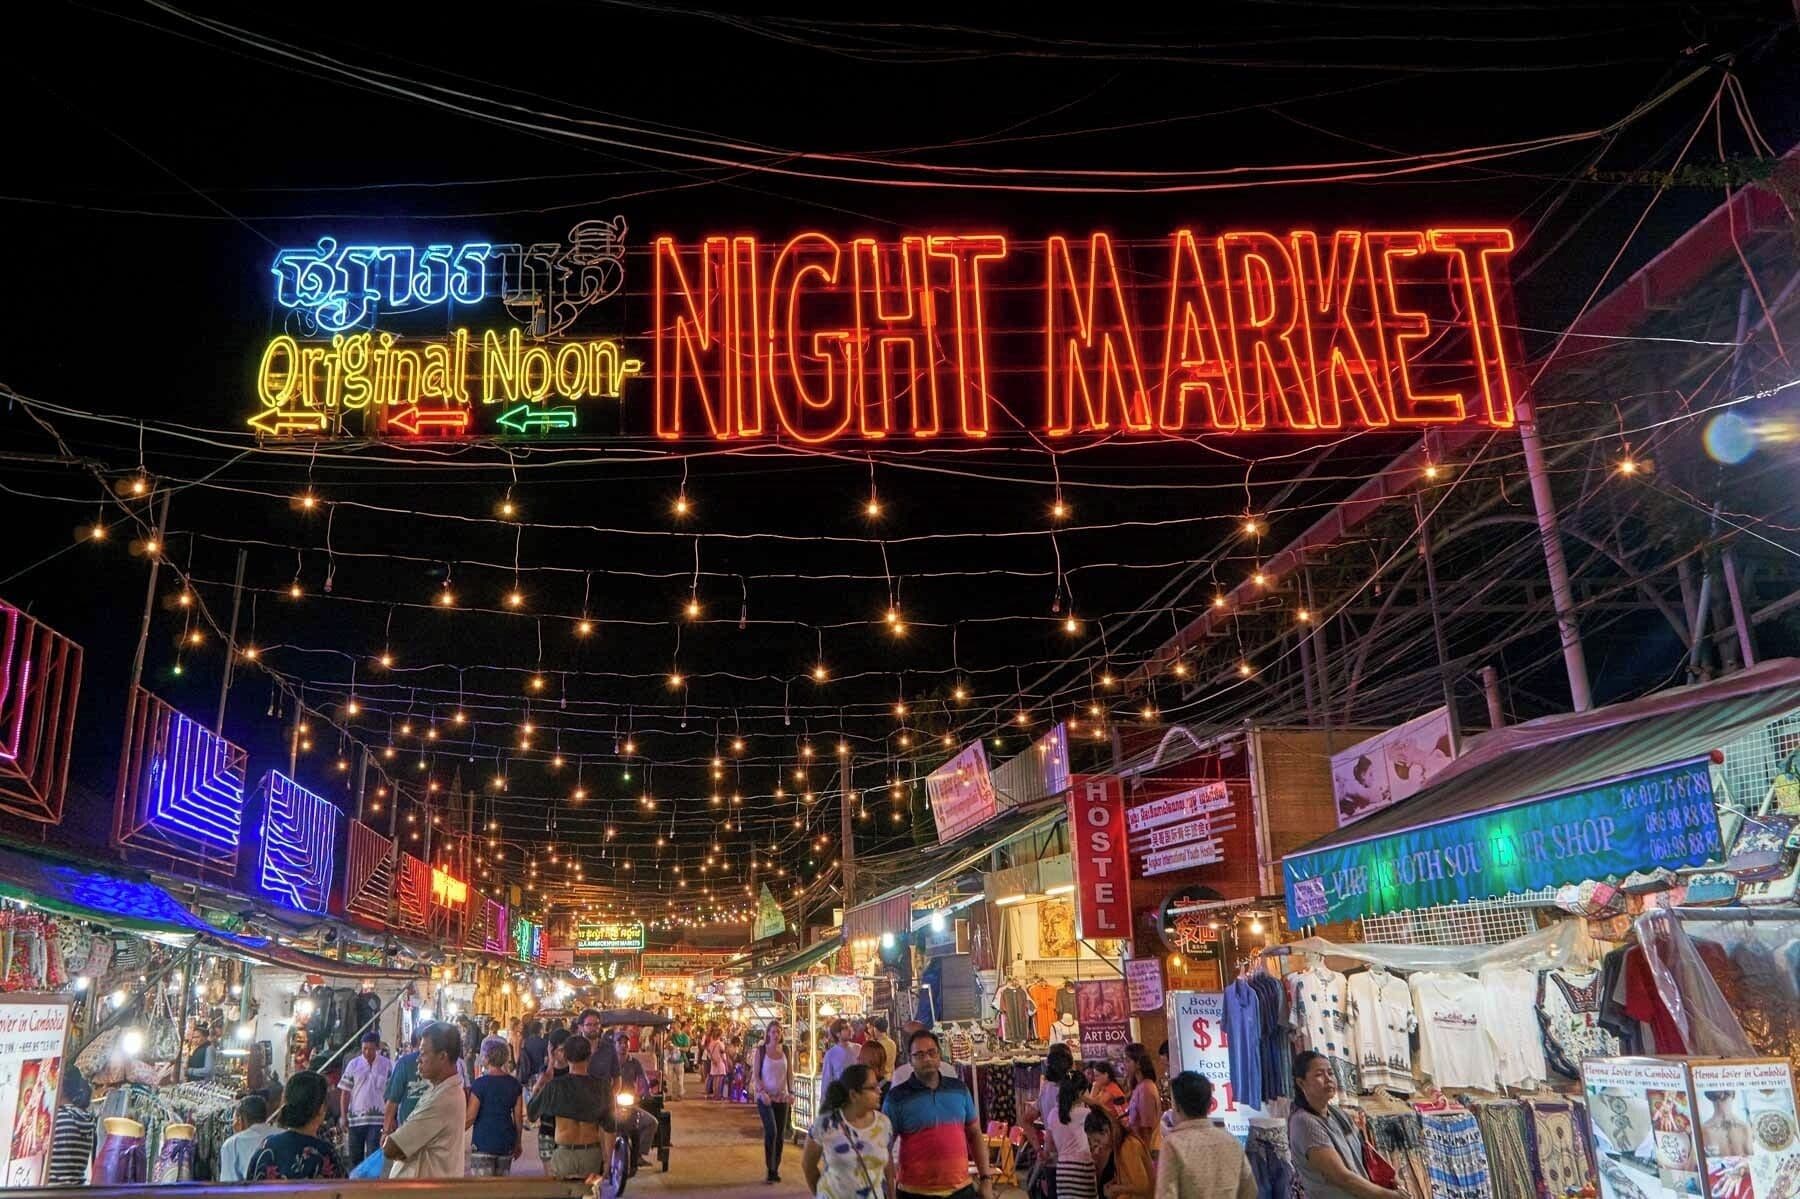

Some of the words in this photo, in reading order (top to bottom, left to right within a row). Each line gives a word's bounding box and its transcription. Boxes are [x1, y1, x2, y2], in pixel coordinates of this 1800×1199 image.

[653, 231, 1007, 443] NIGHT
[1046, 227, 1515, 437] MARKET
[258, 328, 470, 408] Original
[1692, 771, 1710, 794] 88
[1682, 804, 1700, 827] 88
[1086, 781, 1117, 930] HOSTEL
[1444, 830, 1549, 878] SOUENIR
[1551, 815, 1616, 860] SHOP
[1181, 1006, 1223, 1017] Massag
[1189, 997, 1218, 1007] Body
[18, 1013, 28, 1033] in
[29, 1008, 65, 1033] Cambodia
[1084, 1031, 1104, 1042] ART
[1105, 1029, 1129, 1045] BOX
[1199, 1060, 1226, 1070] Foot
[1585, 1063, 1609, 1076] Henna
[1611, 1065, 1633, 1077] Lover
[1635, 1067, 1643, 1078] in
[1644, 1067, 1681, 1080] Cambodia
[1695, 1069, 1719, 1080] Henna
[1721, 1068, 1741, 1079] Lover
[1744, 1067, 1752, 1078] in
[1753, 1066, 1787, 1078] Cambodia
